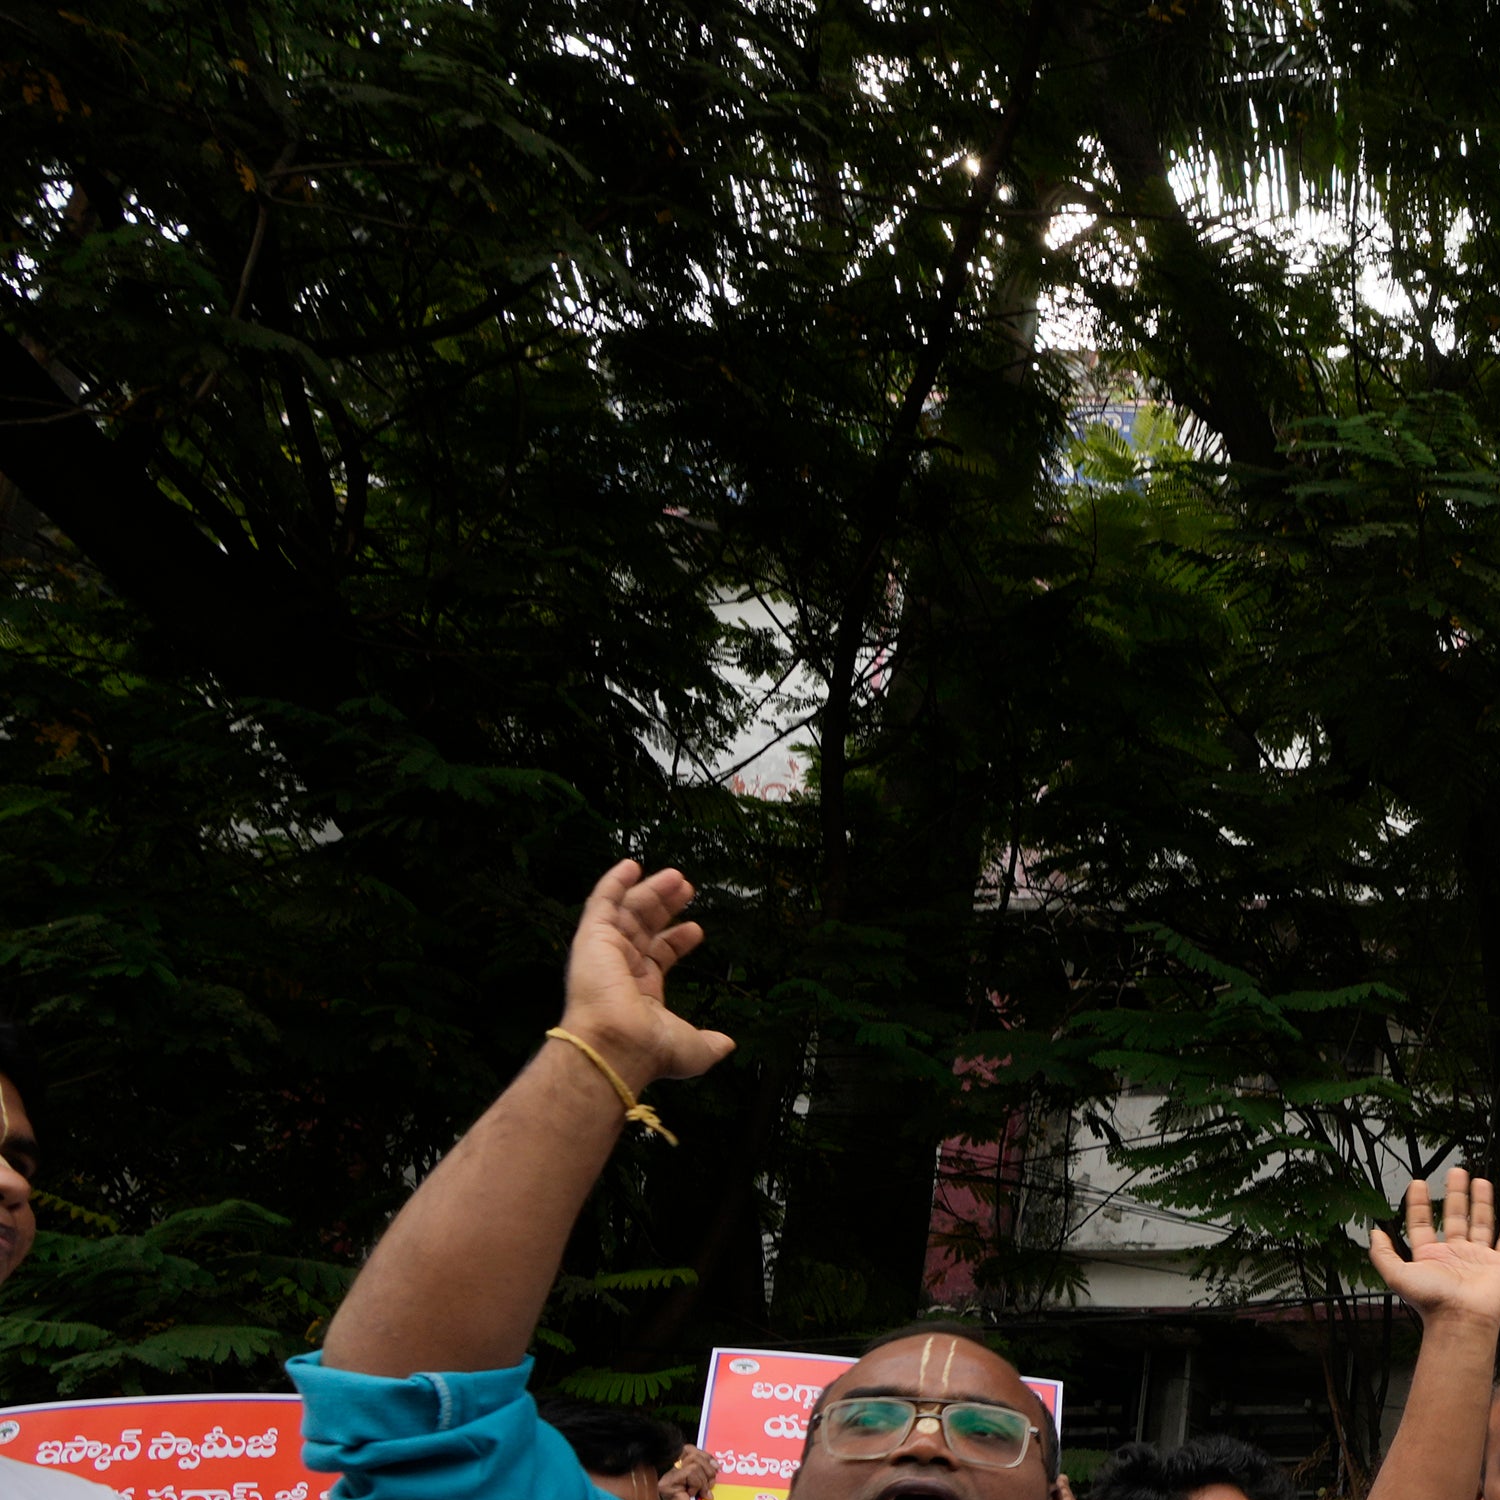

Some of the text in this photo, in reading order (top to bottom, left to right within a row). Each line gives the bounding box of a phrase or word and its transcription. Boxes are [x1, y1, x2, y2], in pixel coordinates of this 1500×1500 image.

[752, 1381, 825, 1410] బంగ్లా
[36, 1429, 142, 1471] ఇస్కాన్
[148, 1426, 278, 1470] స్వామీజీ
